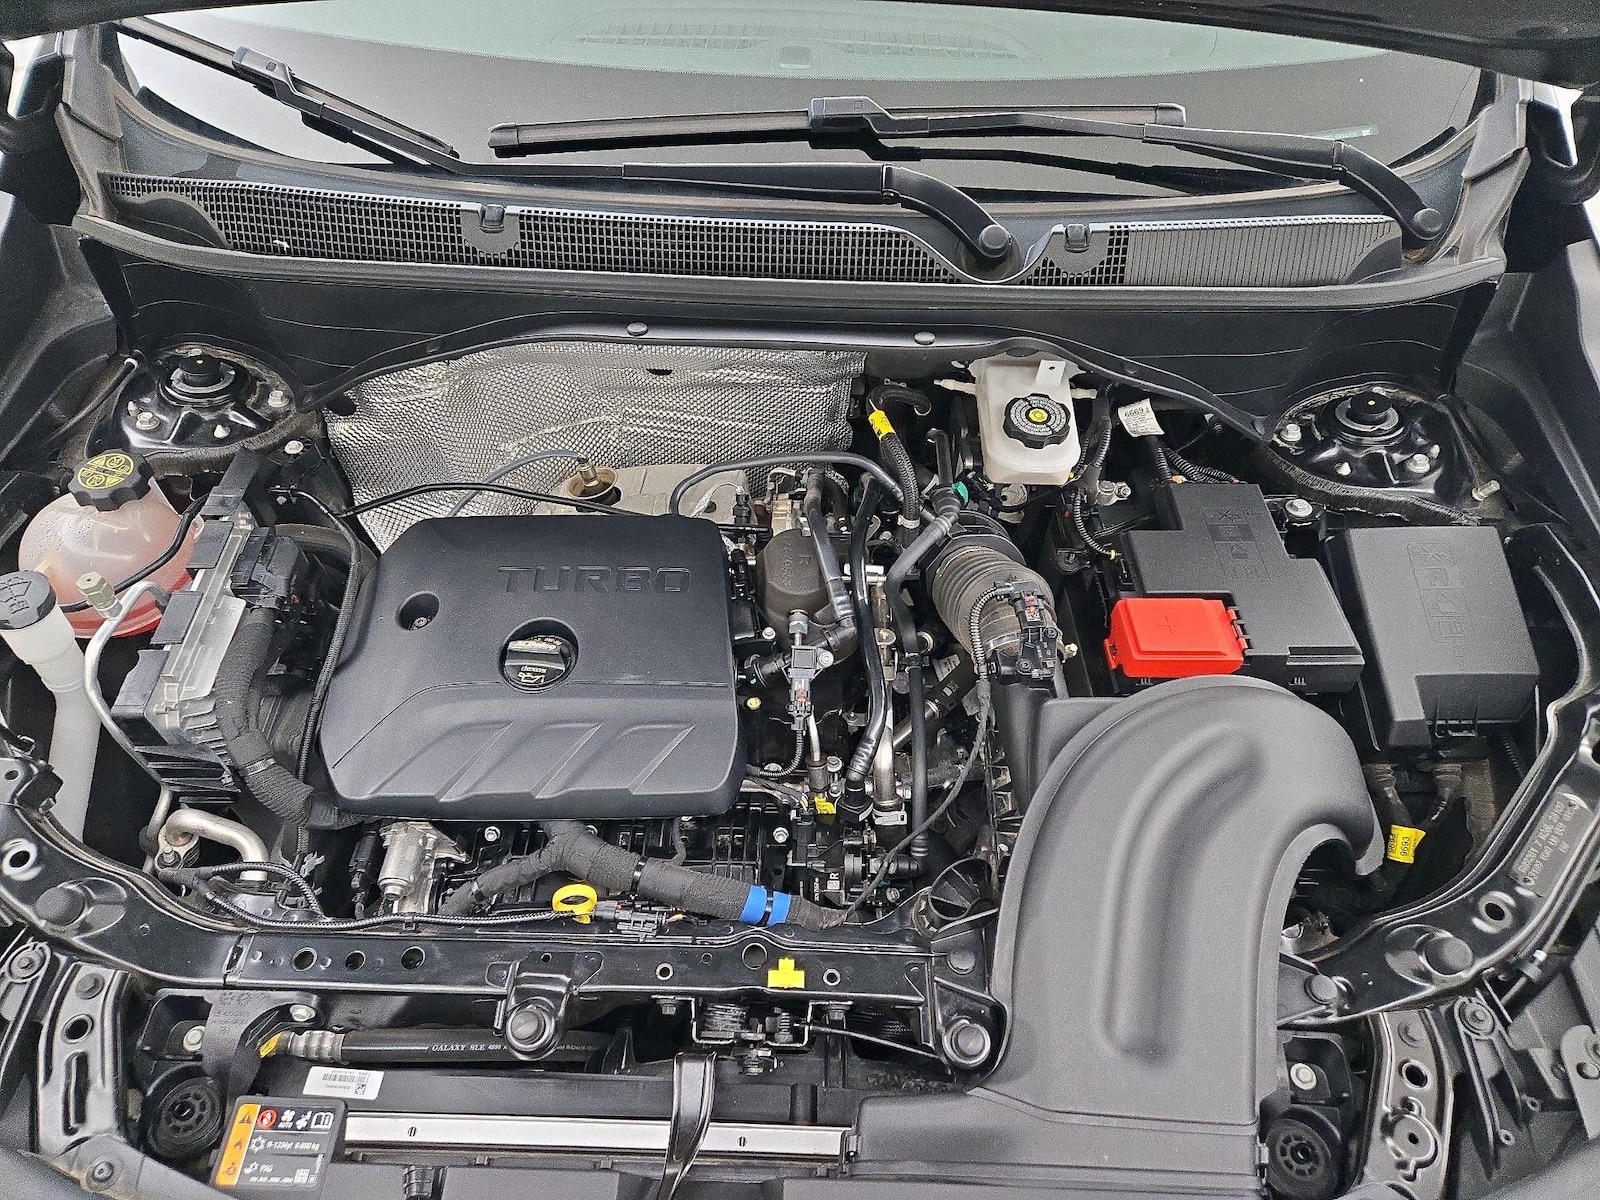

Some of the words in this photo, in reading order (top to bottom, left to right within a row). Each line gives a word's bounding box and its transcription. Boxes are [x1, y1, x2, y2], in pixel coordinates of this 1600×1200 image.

[498, 565, 691, 593] TURBO
[521, 665, 547, 674] dexos
[1400, 836, 1410, 857] 9693
[431, 1044, 467, 1052] GALAXY
